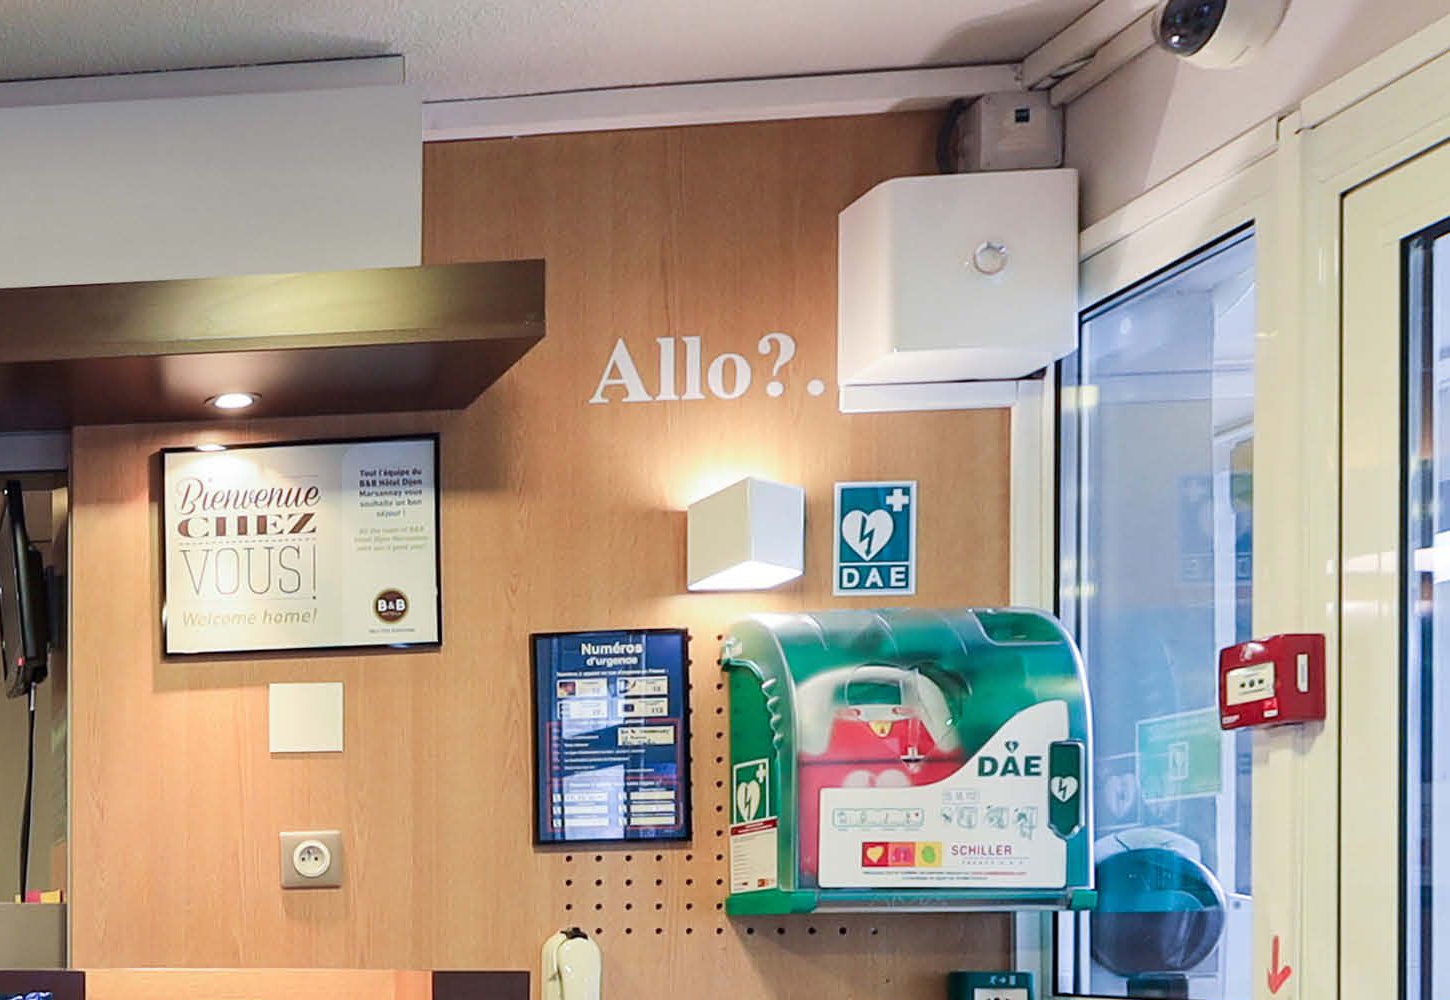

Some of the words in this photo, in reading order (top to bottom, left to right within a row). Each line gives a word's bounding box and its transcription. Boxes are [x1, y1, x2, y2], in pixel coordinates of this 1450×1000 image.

[175, 477, 321, 515] Bienvenue
[177, 513, 317, 538] CHEZ
[842, 566, 907, 589] DAE
[377, 599, 406, 612] B&B
[183, 611, 257, 627] Welcome
[262, 608, 318, 625] home!
[581, 641, 643, 655] Numéros
[586, 656, 639, 667] d'urgence
[978, 755, 1043, 777] DAE
[951, 844, 1012, 856] SCHILLER
